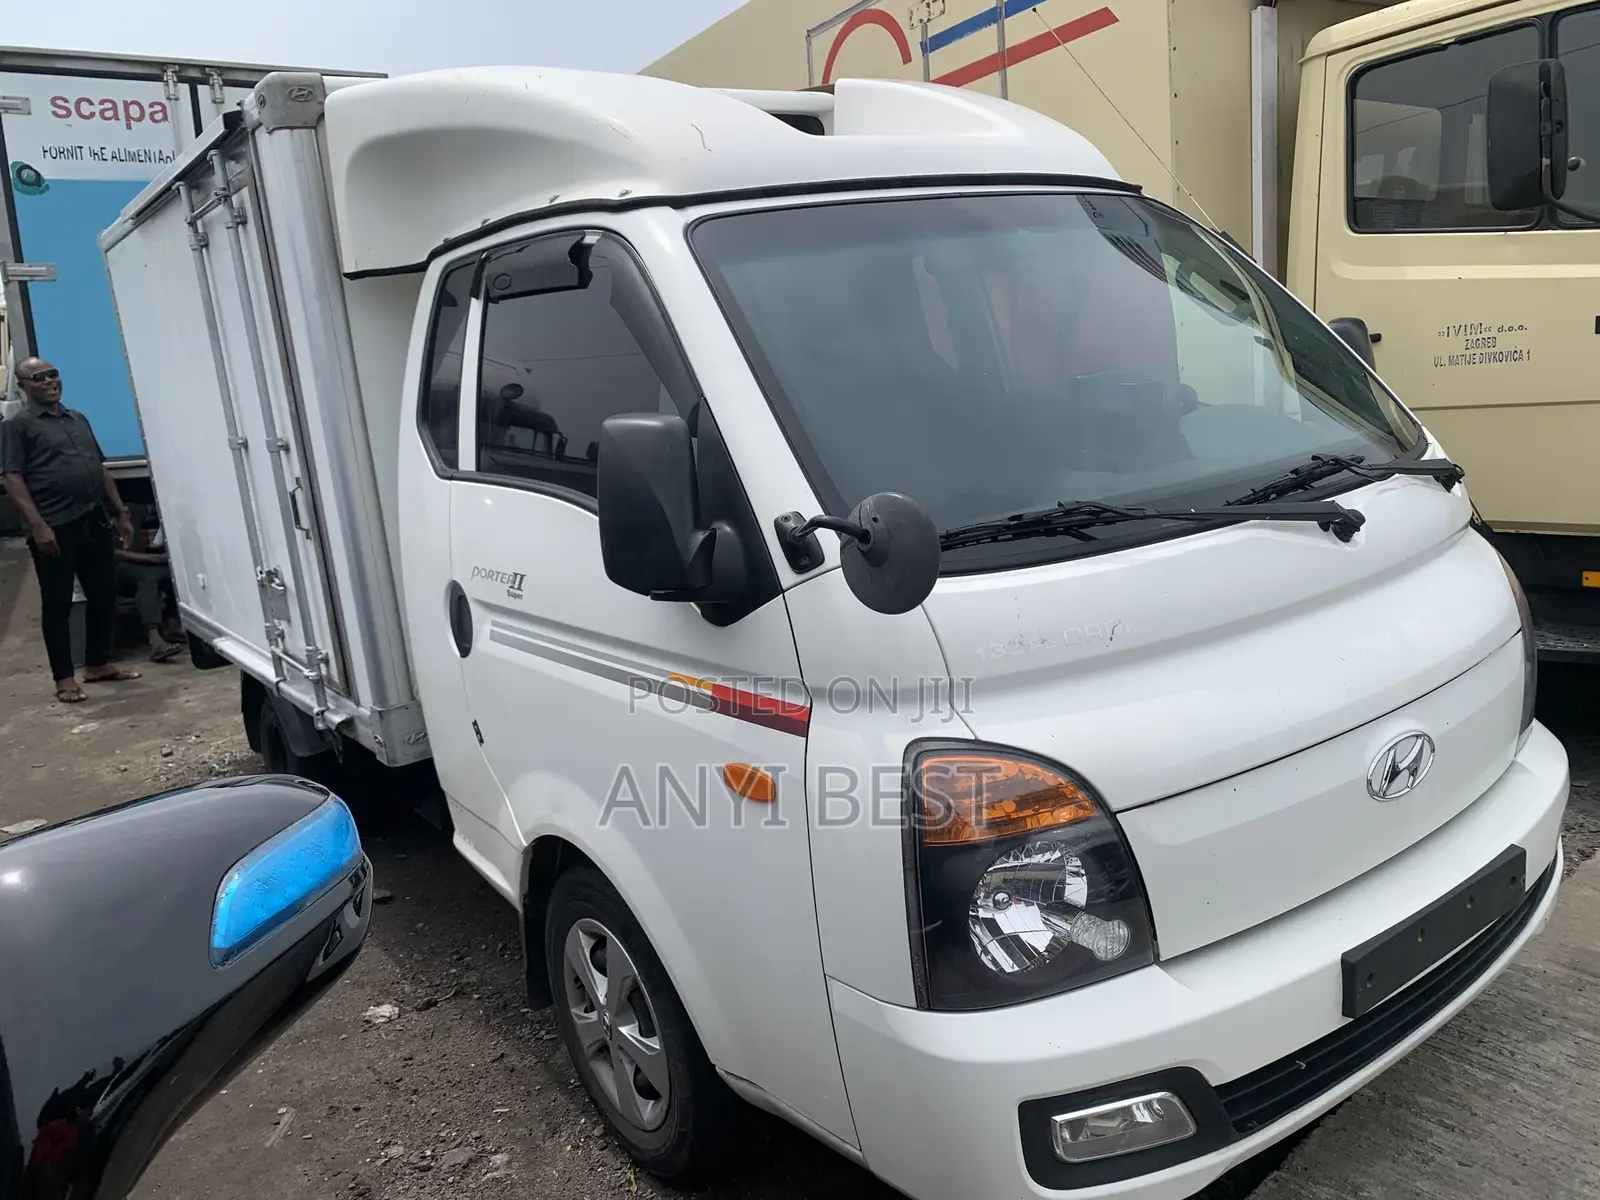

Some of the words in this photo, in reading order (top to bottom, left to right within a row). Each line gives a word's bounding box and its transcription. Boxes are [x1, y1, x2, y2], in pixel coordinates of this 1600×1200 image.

[50, 95, 170, 131] scapa
[1497, 324, 1528, 333] d.o.o.
[1464, 336, 1497, 350] ZAGREB
[1433, 355, 1446, 368] UL.
[1448, 353, 1476, 367] MATIJE
[1526, 349, 1531, 361] 1
[471, 566, 515, 585] PORTER
[506, 589, 523, 600] Super
